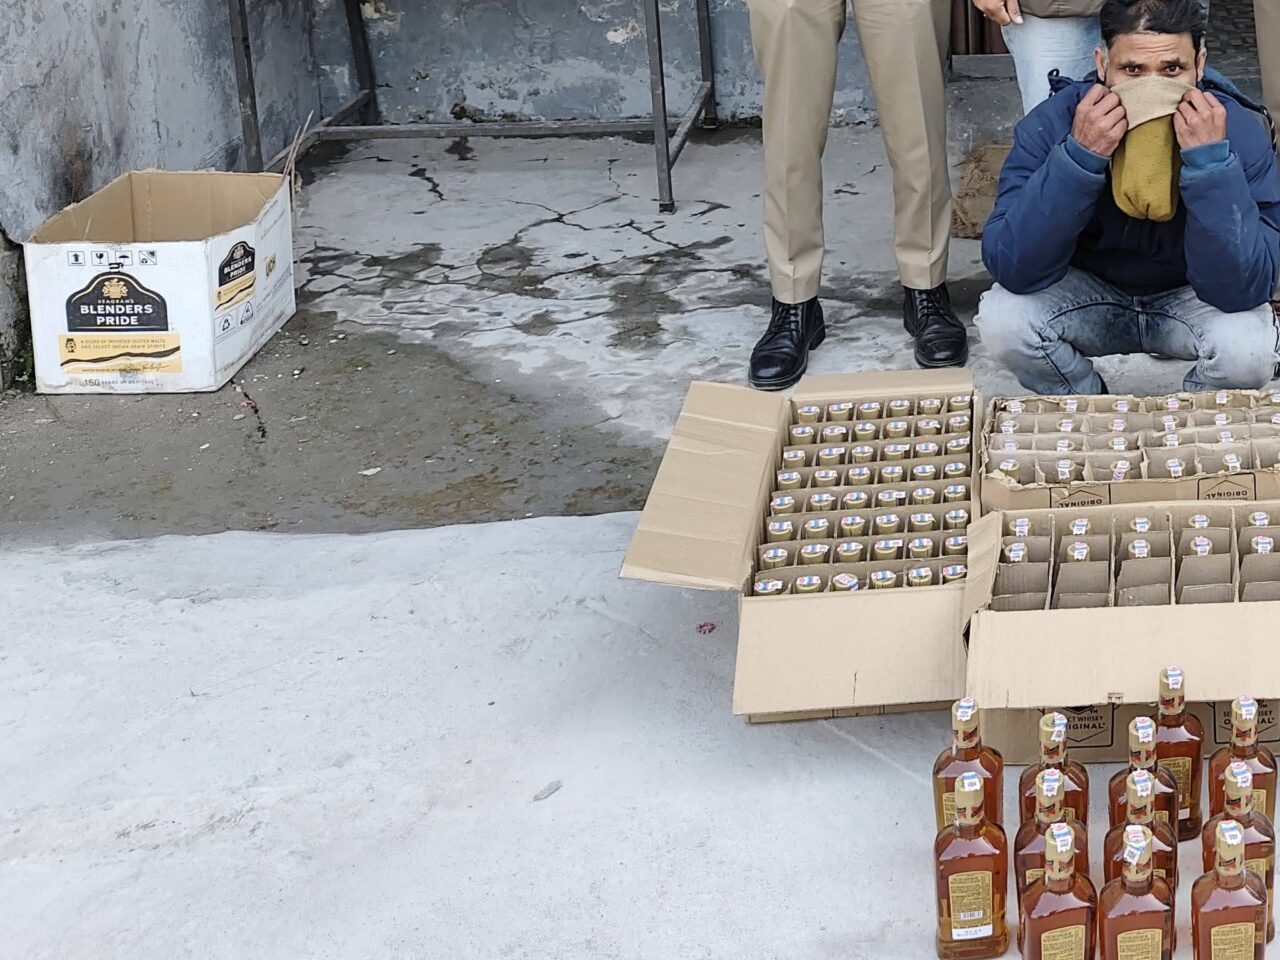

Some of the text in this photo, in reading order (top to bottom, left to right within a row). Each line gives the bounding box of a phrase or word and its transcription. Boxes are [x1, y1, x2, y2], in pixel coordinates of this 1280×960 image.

[223, 257, 252, 274] BLENDERS
[80, 304, 153, 314] BLENDERS
[96, 316, 139, 325] PRIDE
[84, 378, 100, 387] 150
[1205, 490, 1248, 500] ORIGINAL
